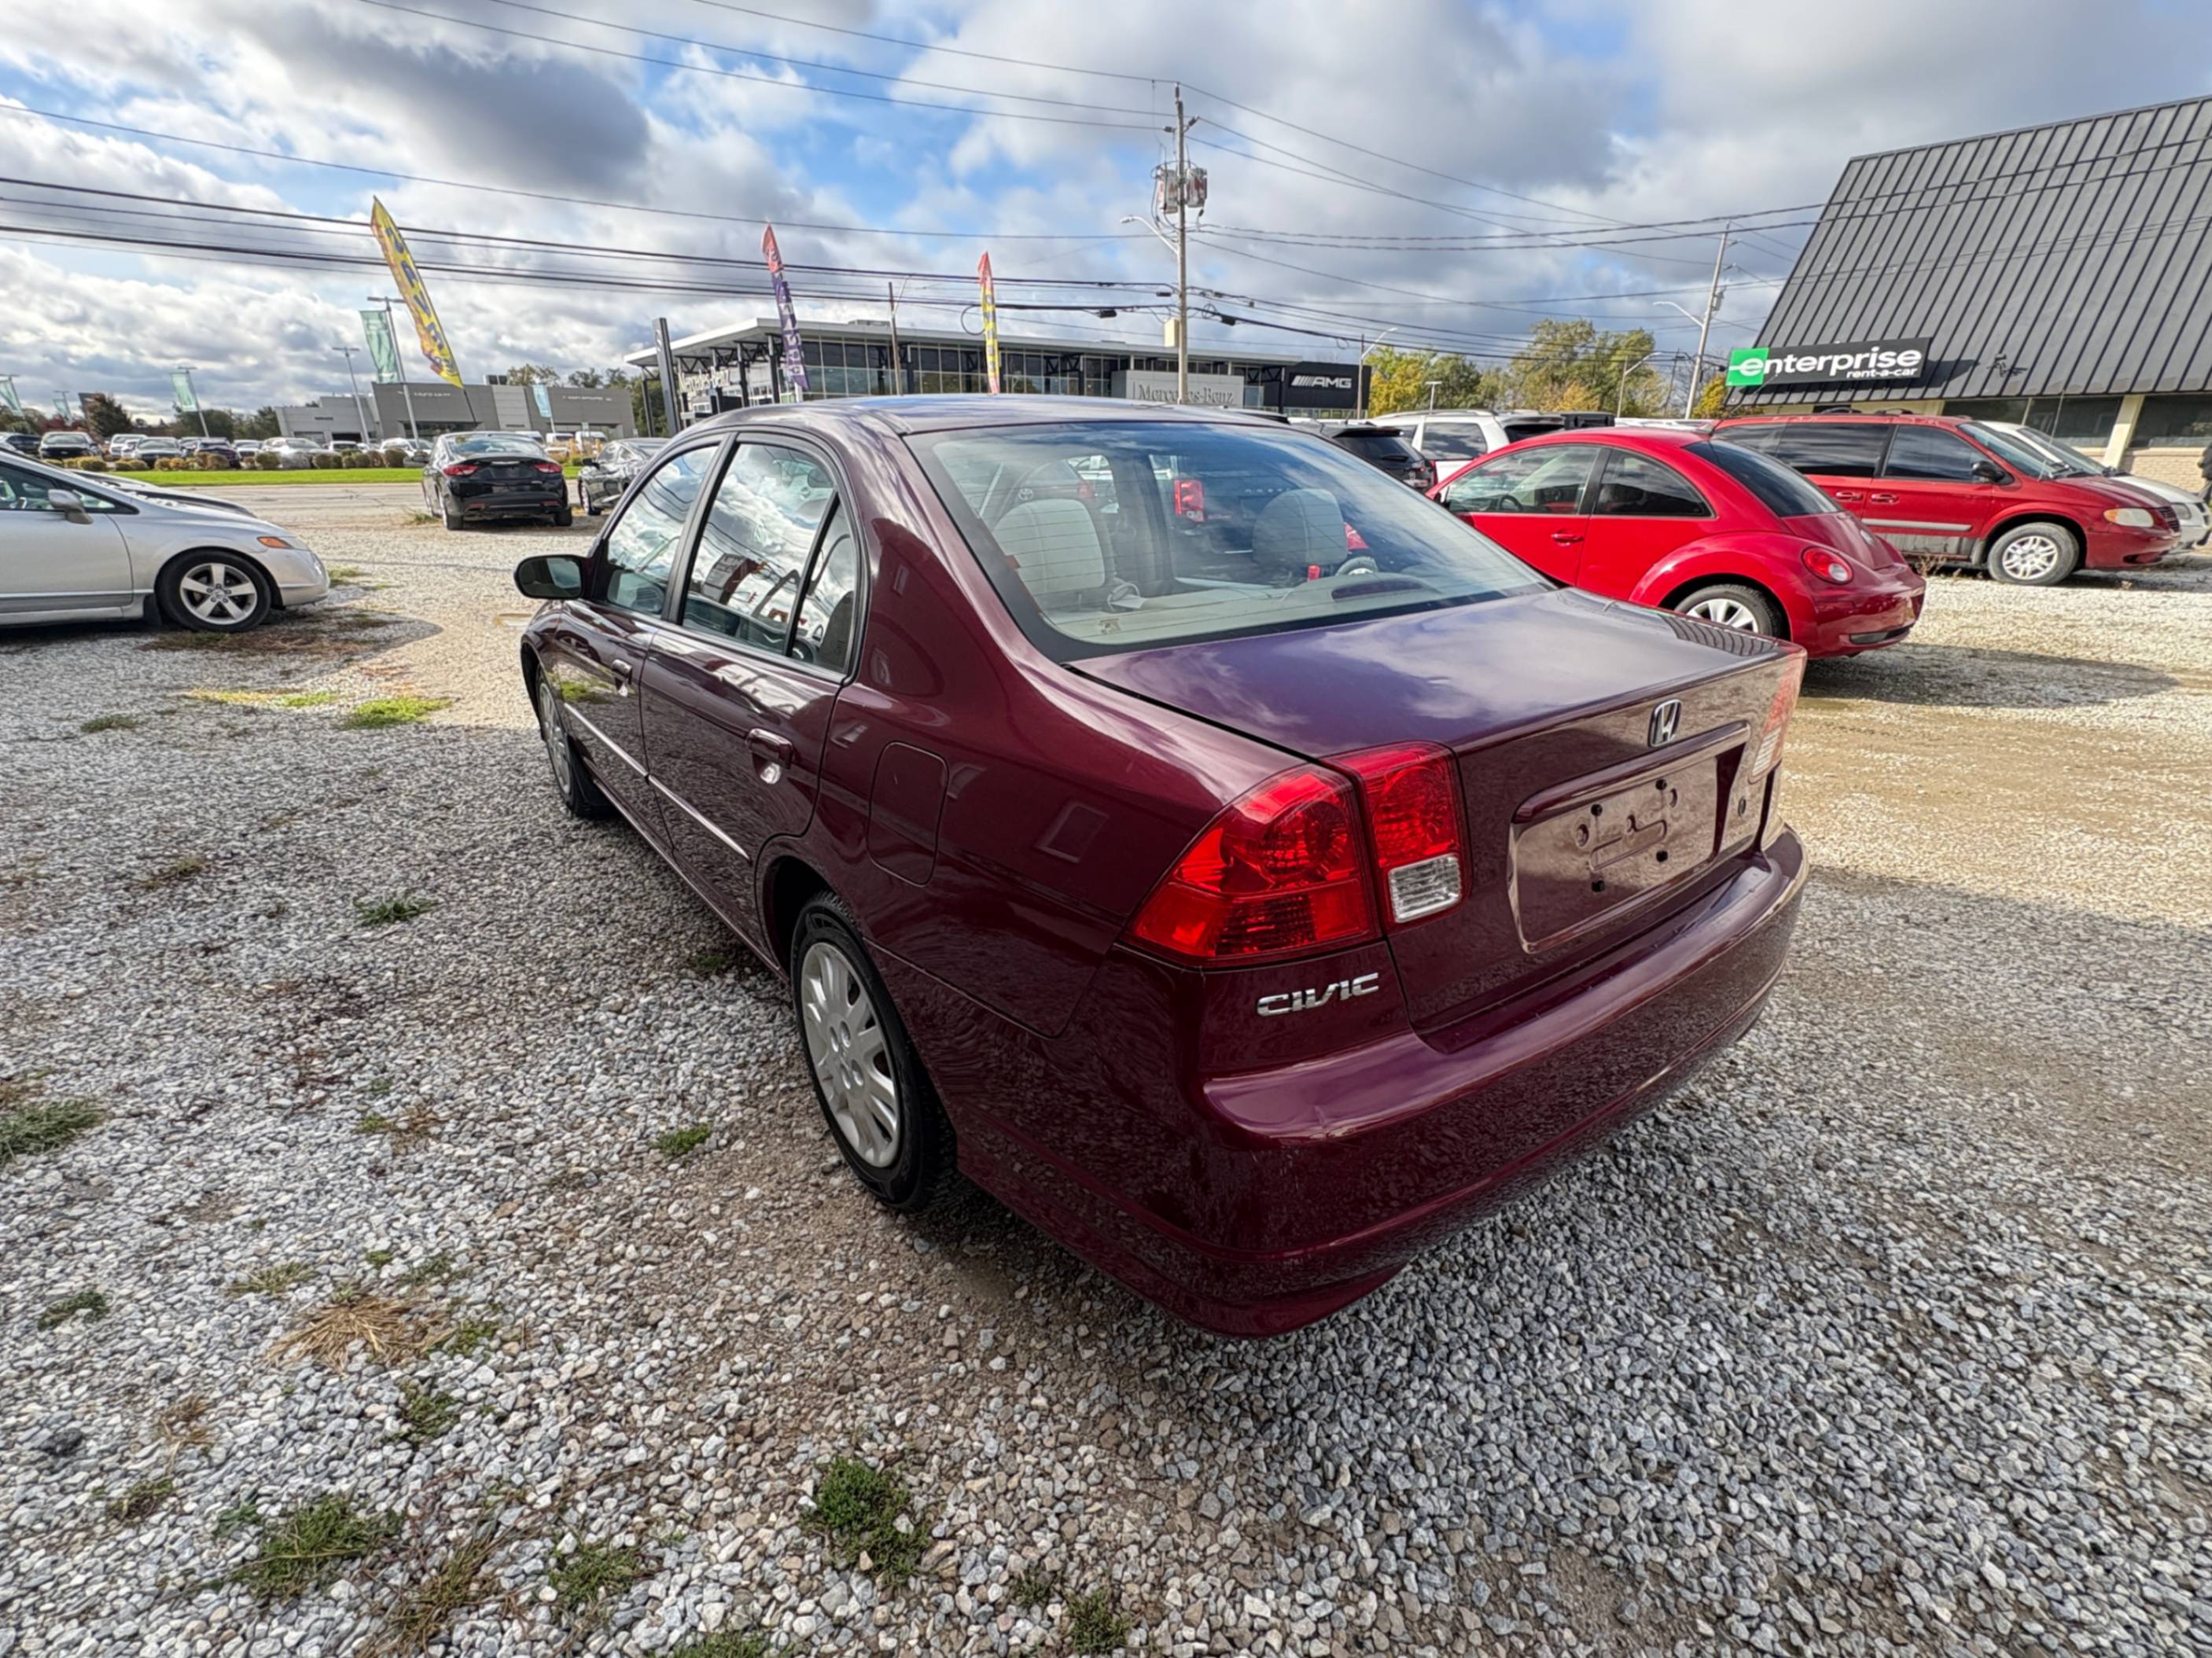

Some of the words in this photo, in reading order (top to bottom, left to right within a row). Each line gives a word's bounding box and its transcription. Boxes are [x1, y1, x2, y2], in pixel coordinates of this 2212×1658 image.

[1729, 346, 1922, 377] enterprise
[1312, 375, 1352, 389] AMG
[1846, 367, 1918, 379] rent-a-car
[1139, 384, 1234, 404] Mercees-Benz
[1257, 972, 1379, 1016] CIVIC
